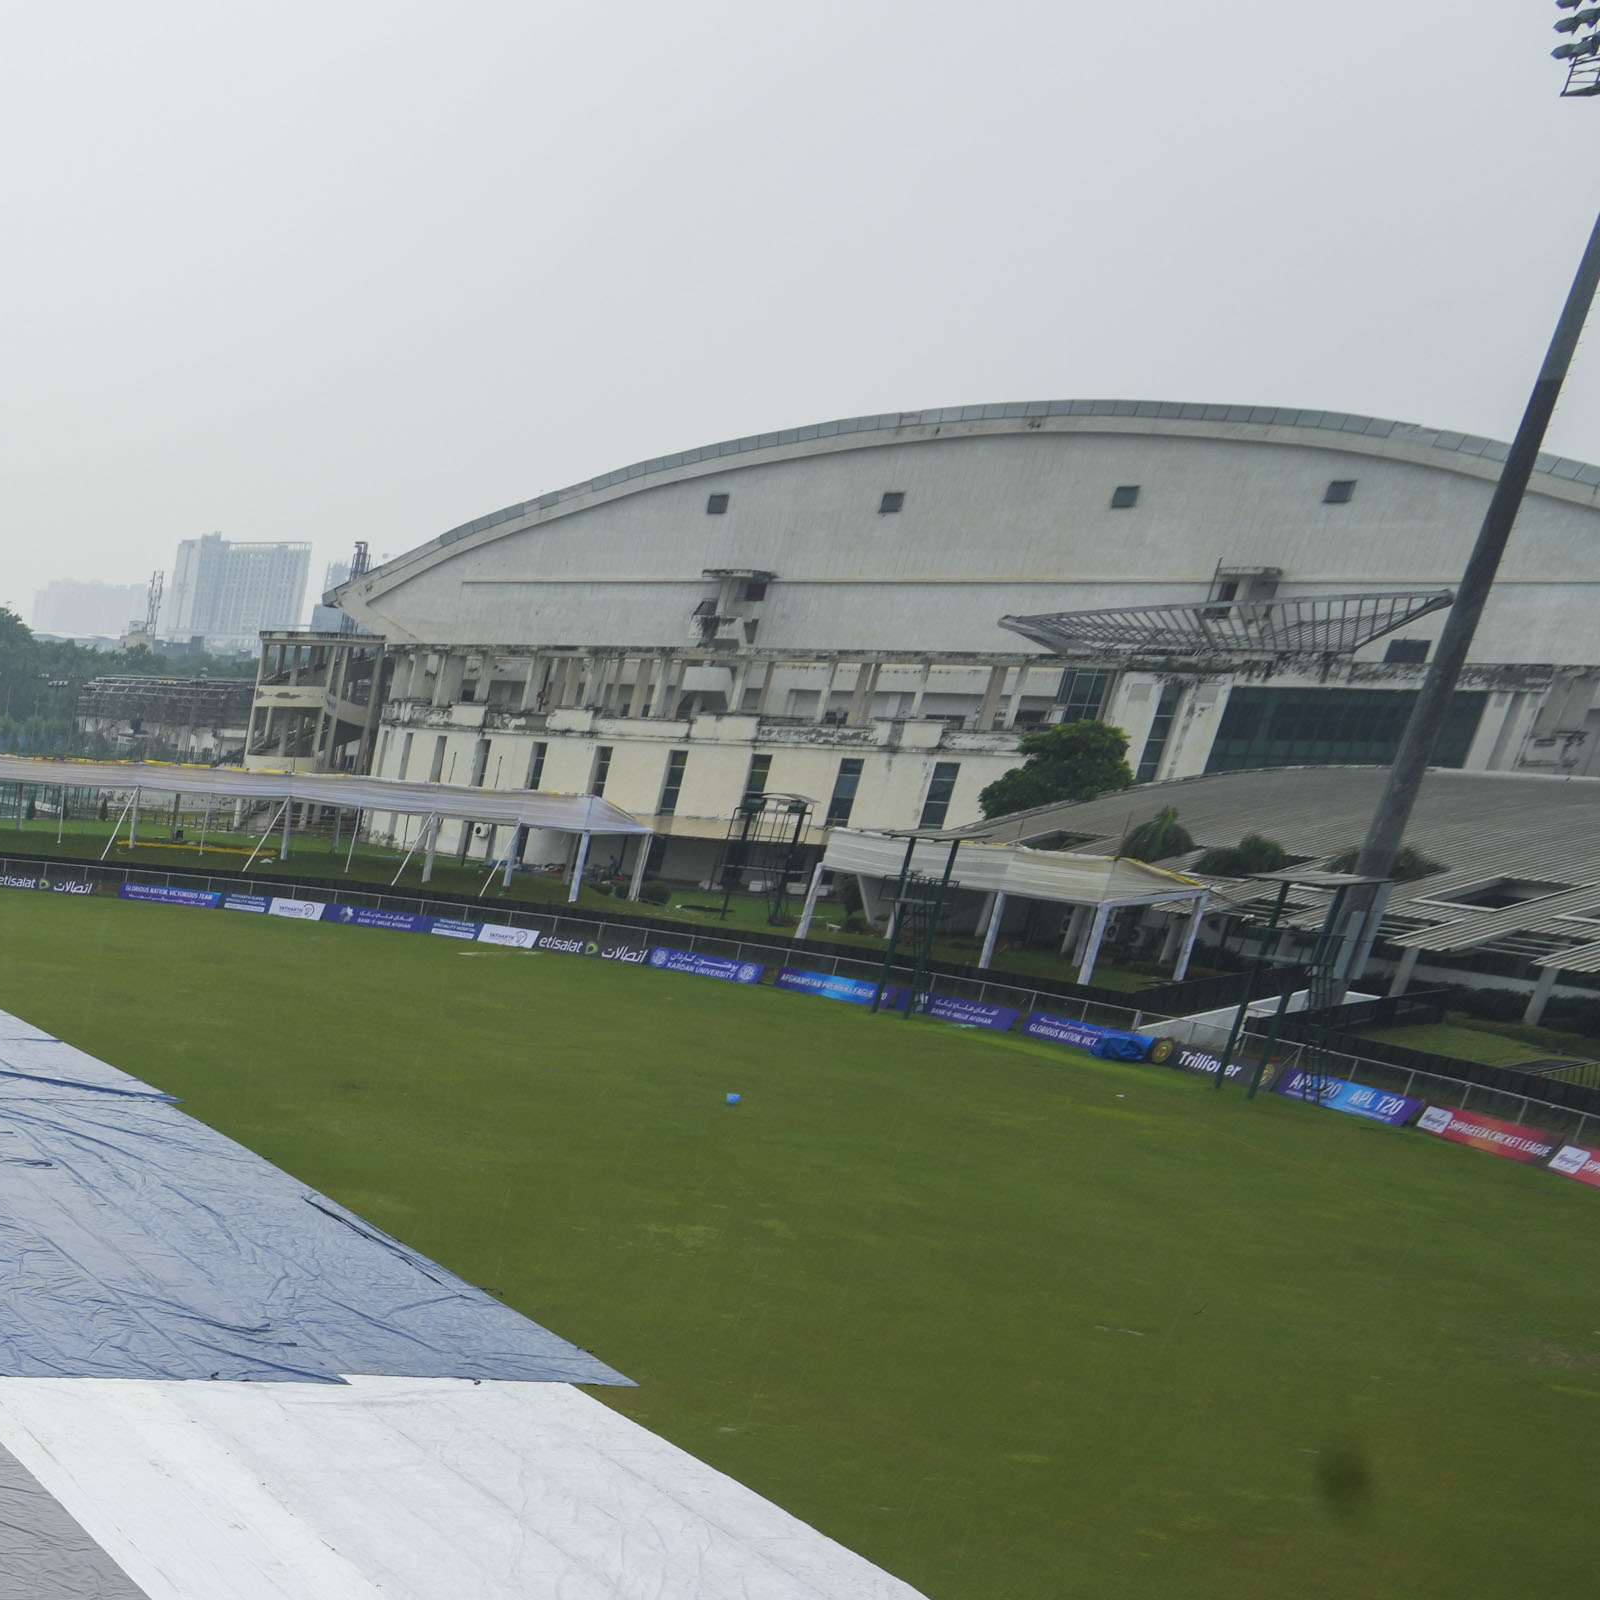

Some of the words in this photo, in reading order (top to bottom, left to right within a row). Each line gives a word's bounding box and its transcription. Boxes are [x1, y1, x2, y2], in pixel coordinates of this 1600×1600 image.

[539, 935, 584, 953] etisalat
[666, 962, 695, 972] KARDAN
[695, 967, 735, 979] UNIVERSITY
[781, 973, 821, 988] AFGHANISTAN
[1029, 1023, 1060, 1038] GLORIOUS
[1178, 1051, 1243, 1077] Trillioer
[1347, 1089, 1377, 1108] APL
[1375, 1095, 1406, 1116] T20
[1448, 1119, 1489, 1141] SHPAGEEZA
[1488, 1130, 1522, 1148] CRICKET
[1519, 1140, 1553, 1157] LEAGUE
